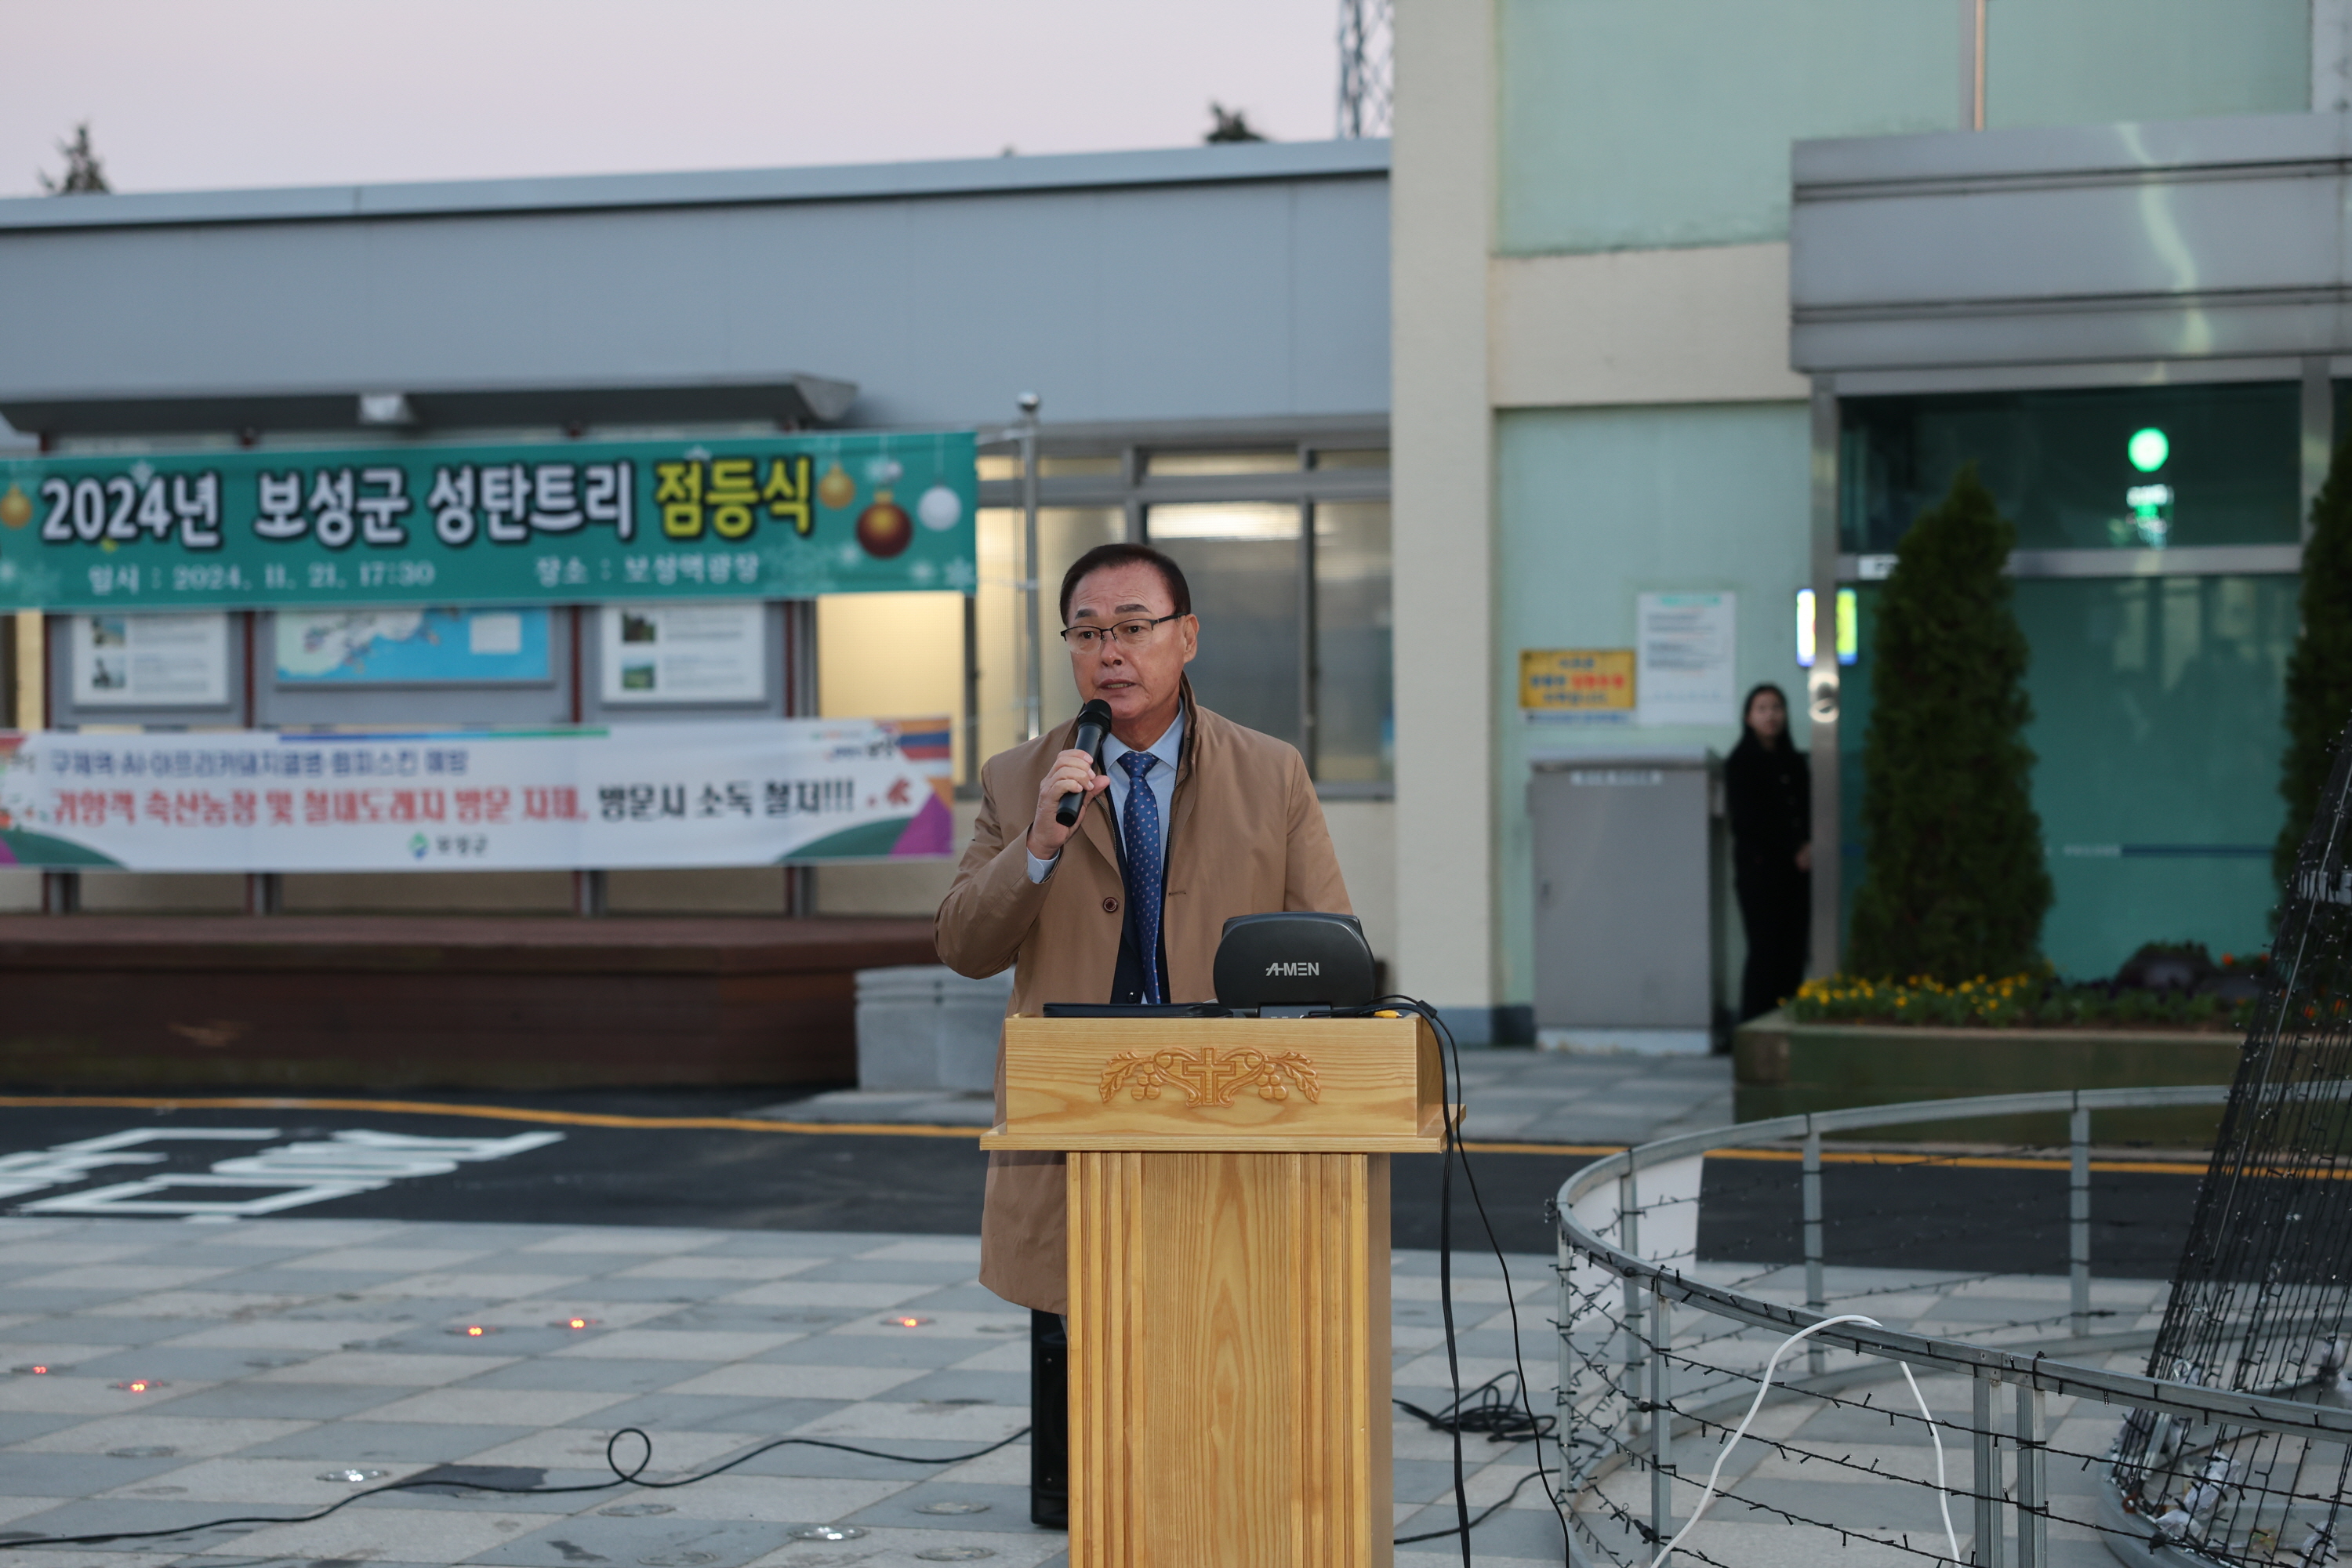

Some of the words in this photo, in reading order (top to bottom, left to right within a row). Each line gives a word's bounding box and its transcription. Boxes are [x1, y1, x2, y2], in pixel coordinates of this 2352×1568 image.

[40, 470, 222, 549] 2024년
[252, 467, 409, 547] 보성군
[427, 462, 632, 545] 성탄트리
[653, 455, 813, 539] 점등식
[358, 559, 437, 588] 17:30
[598, 780, 688, 823] 방문시
